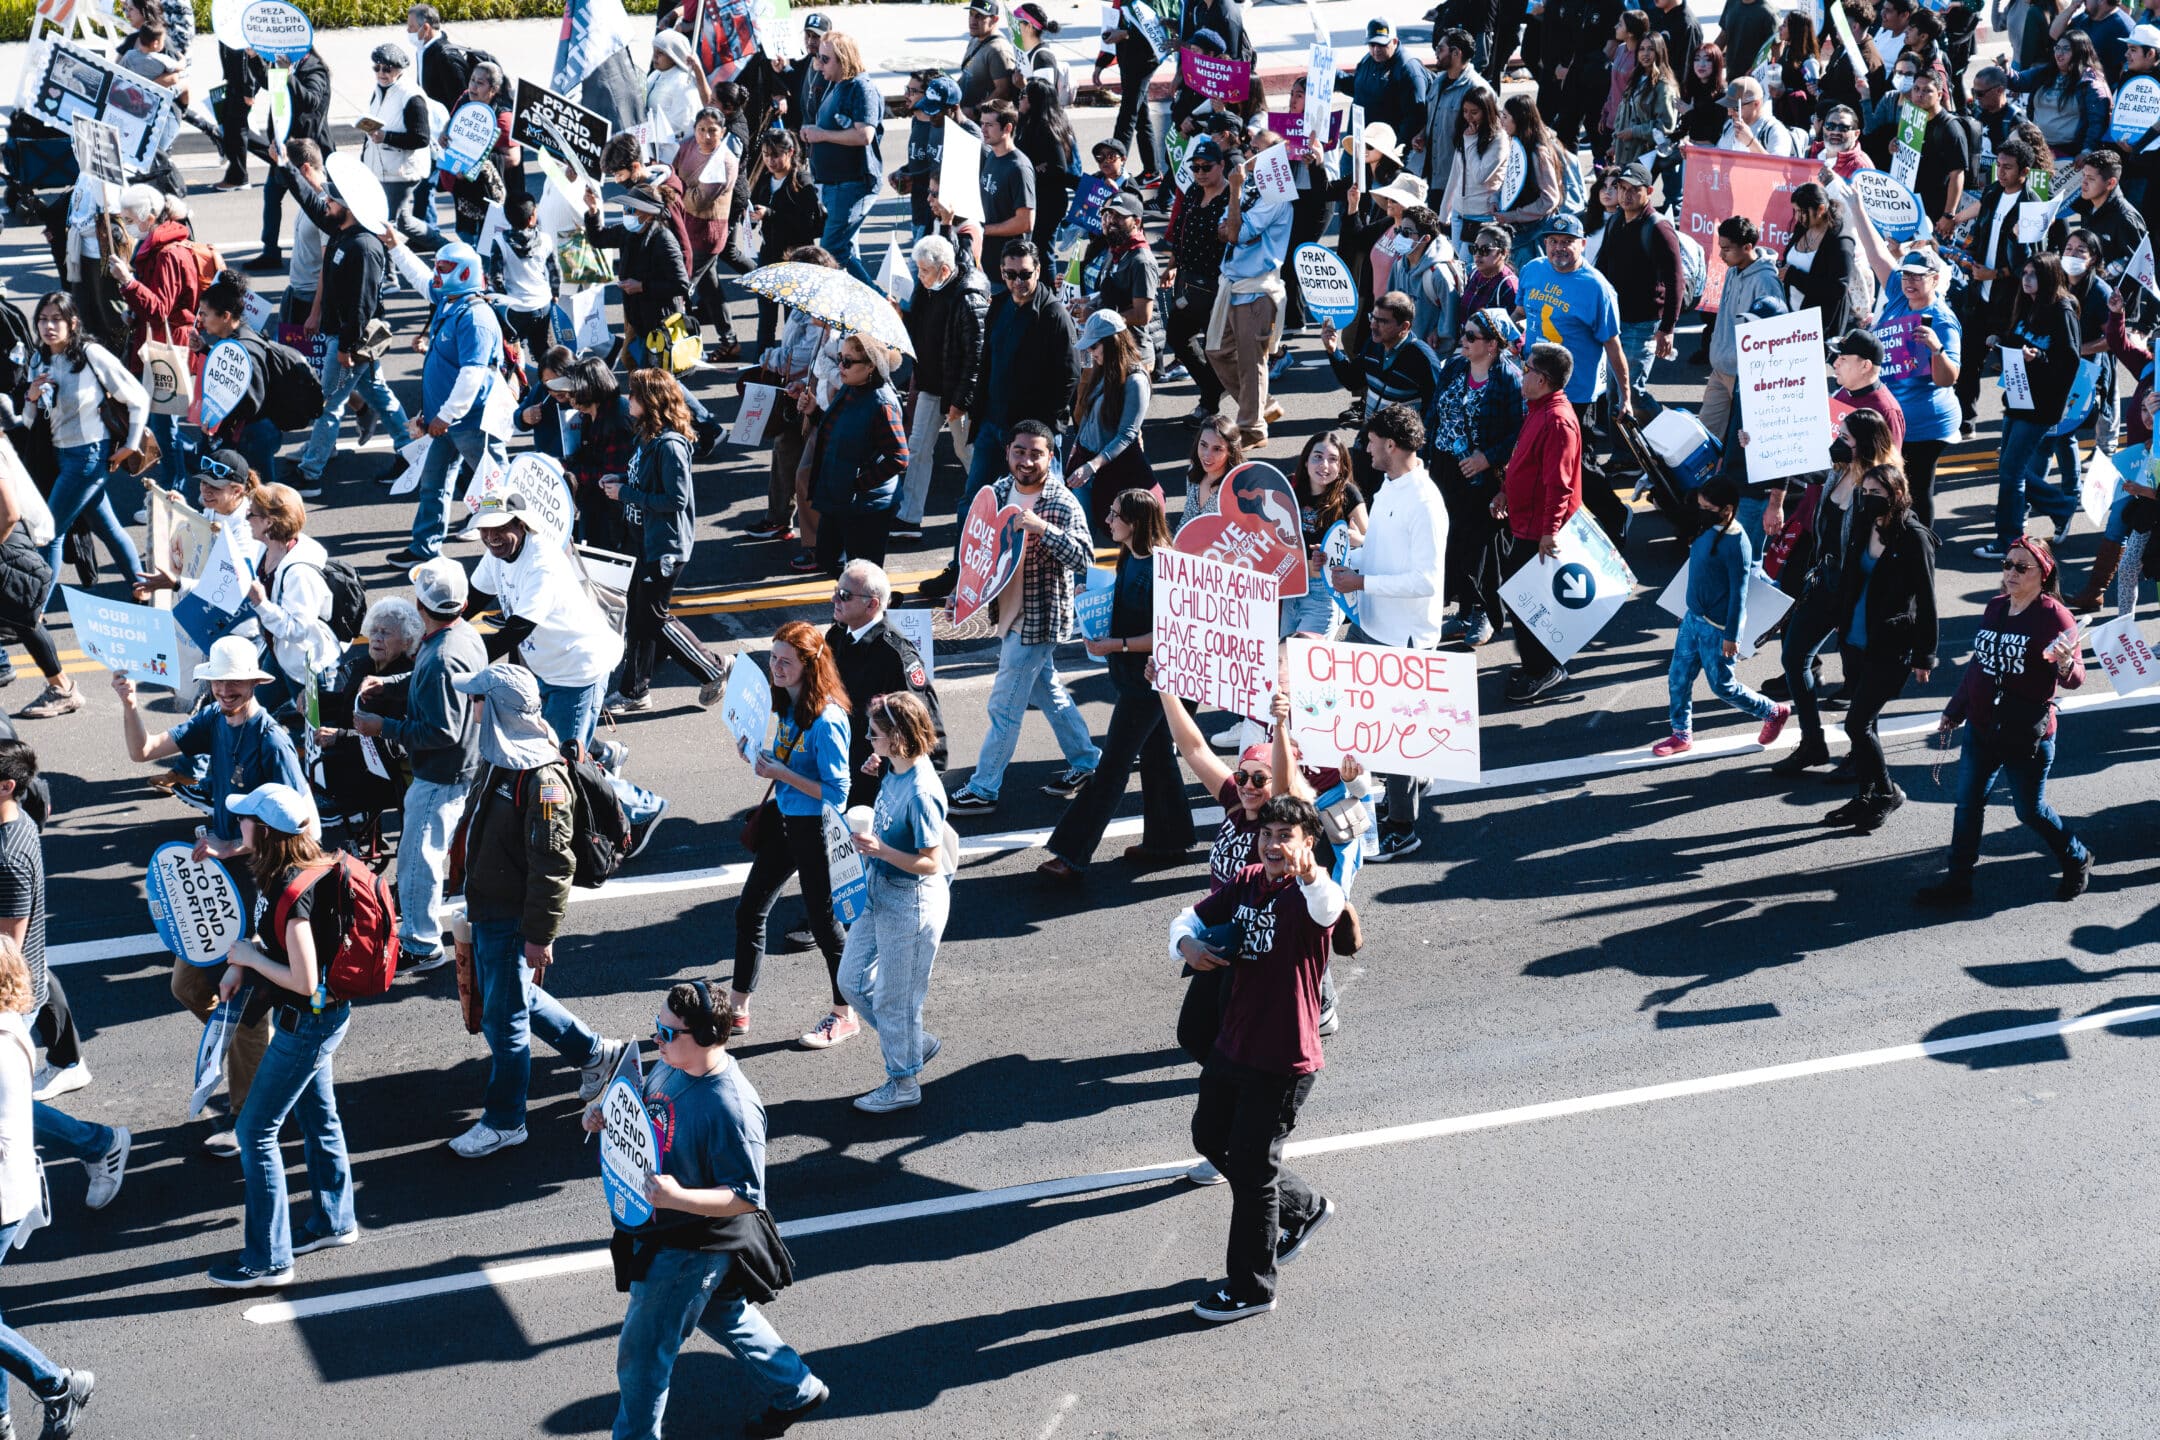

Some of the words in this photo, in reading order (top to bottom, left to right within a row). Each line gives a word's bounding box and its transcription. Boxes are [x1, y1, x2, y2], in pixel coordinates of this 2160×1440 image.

[250, 15, 268, 24] POR
[285, 16, 301, 24] FIN
[260, 7, 285, 15] REZA
[266, 25, 305, 33] ABORTO
[1144, 23, 1166, 53] ABORTO
[1194, 57, 1232, 72] NUESTRA
[1313, 46, 1333, 75] Right
[1197, 67, 1230, 81] MISIÓN
[1207, 80, 1217, 88] ES
[1306, 78, 1314, 96] to
[1318, 78, 1332, 103] Life
[2125, 94, 2138, 103] POR
[2140, 95, 2148, 103] EL
[2149, 96, 2160, 105] FIN
[2136, 84, 2152, 94] REZA
[471, 110, 488, 123] REZA
[543, 94, 584, 121] PRAY
[2118, 103, 2131, 112] DEL
[2131, 104, 2159, 114] ABORTO
[459, 116, 473, 128] POR
[473, 122, 482, 131] EL
[481, 125, 490, 136] FIN
[531, 102, 555, 120] TO
[557, 114, 590, 138] END
[452, 124, 465, 137] DEL
[465, 130, 488, 147] ABORTO
[1256, 169, 1267, 191] LOVE
[1265, 173, 1273, 182] IS
[1271, 157, 1285, 193] MISSION
[1281, 164, 1292, 182] OUR
[1862, 175, 1888, 187] PRAY
[1860, 184, 1872, 195] TO
[1875, 188, 1899, 199] END
[1302, 252, 1326, 262] PRAY
[1300, 264, 1312, 275] TO
[1314, 265, 1337, 276] END
[1528, 288, 1570, 313] Matters
[1544, 282, 1563, 297] Life
[1741, 330, 1819, 354] Corporations
[223, 346, 245, 365] PRAY
[1750, 360, 1766, 376] pay
[1767, 354, 1783, 367] for
[1788, 356, 1808, 370] your
[216, 356, 229, 371] TO
[229, 364, 245, 381] END
[208, 369, 242, 398] ABORTION
[1754, 375, 1806, 392] abortions
[2013, 363, 2025, 400] MISSION
[2021, 372, 2029, 391] OUR
[1766, 391, 1776, 401] to
[1782, 391, 1804, 400] avoid
[1775, 457, 1808, 469] balance
[531, 461, 559, 491] PRAY
[522, 468, 535, 487] TO
[536, 485, 561, 511] END
[513, 476, 564, 532] ABORTION
[968, 514, 996, 549] LOVE
[1203, 521, 1246, 563] OVE
[964, 543, 993, 579] BOTH
[1234, 529, 1277, 571] OTH
[211, 574, 233, 603] One
[1158, 552, 1174, 582] IN
[1177, 557, 1191, 583] A
[1192, 560, 1224, 594] WAR
[1228, 572, 1279, 604] AGAINST
[98, 607, 129, 624] OUR
[1169, 587, 1249, 630] CHILDREN
[87, 619, 148, 642] MISSION
[1096, 618, 1109, 628] ES
[111, 641, 126, 654] IS
[1157, 615, 1198, 650] HAVE
[1205, 629, 1266, 666] COURAGE
[2006, 645, 2027, 658] OF
[2134, 639, 2152, 661] OUR
[2099, 652, 2120, 677] LOVE
[2115, 653, 2127, 665] IS
[2118, 633, 2147, 676] MISSION
[1156, 642, 1212, 679] CHOOSE
[1218, 657, 1260, 693] LOVE
[1307, 645, 1450, 693] CHOOSE
[1155, 665, 1213, 706] CHOOSE
[1218, 683, 1257, 720] LIFE
[1344, 688, 1375, 710] TO
[1233, 846, 1251, 859] OF
[152, 861, 183, 956] 40DaysForLife.com
[173, 854, 216, 954] ABORTION
[193, 863, 209, 891] TO
[203, 896, 225, 937] END
[211, 874, 238, 921] PRAY
[1257, 914, 1277, 928] OF
[617, 1087, 640, 1122] PRAY
[610, 1101, 622, 1126] TO
[623, 1121, 646, 1149] END
